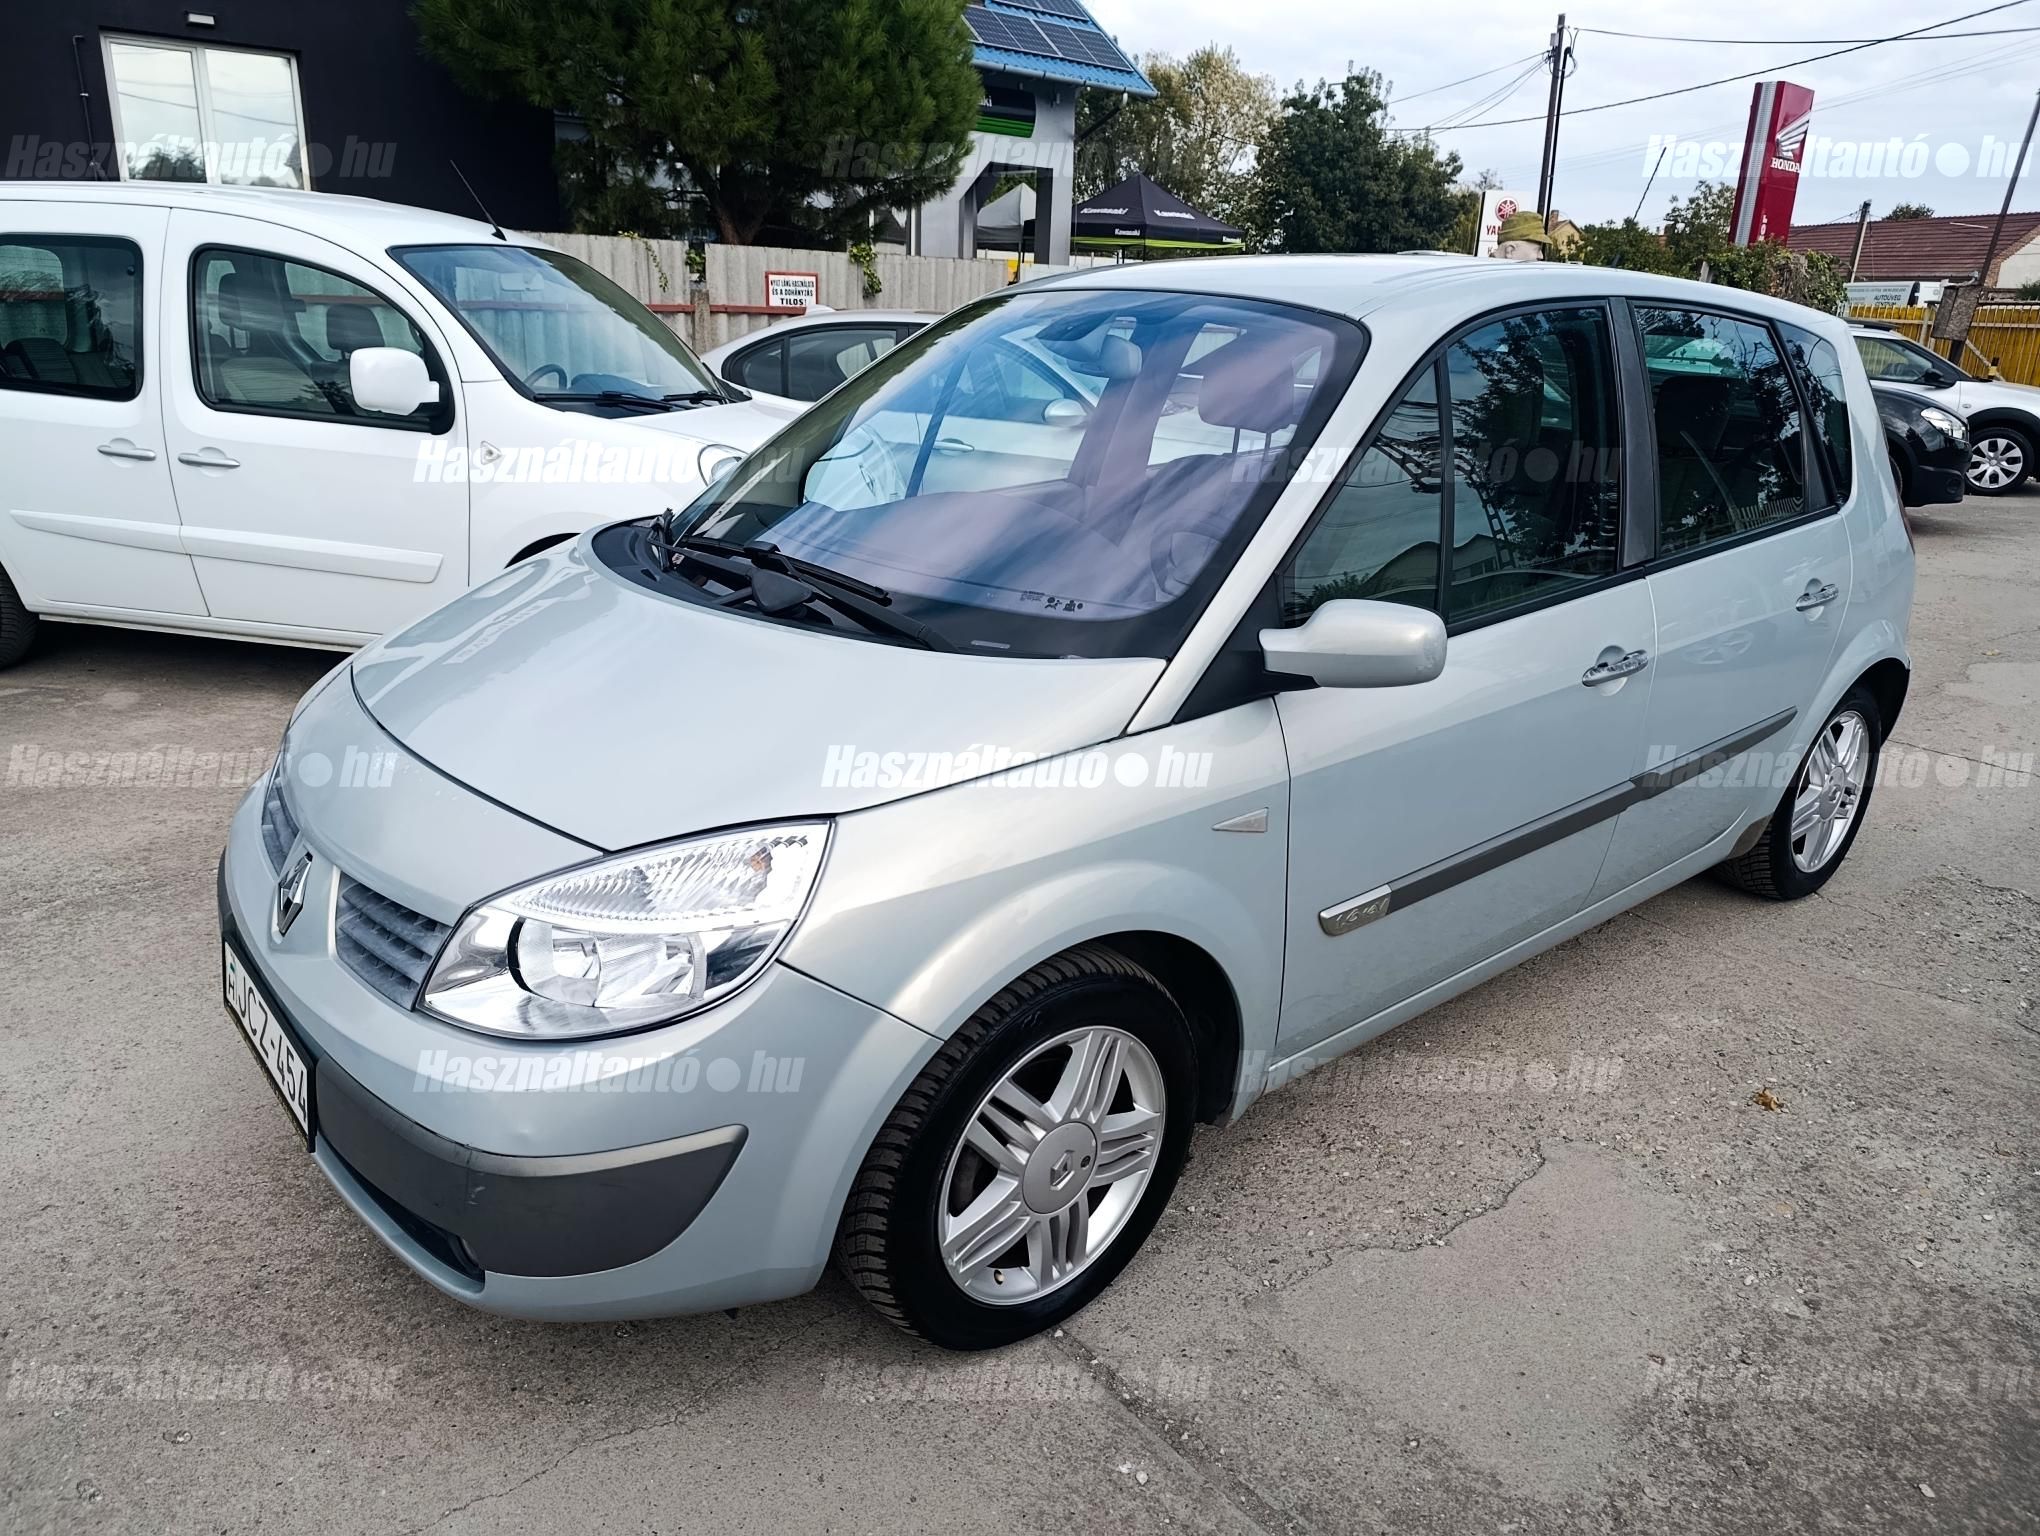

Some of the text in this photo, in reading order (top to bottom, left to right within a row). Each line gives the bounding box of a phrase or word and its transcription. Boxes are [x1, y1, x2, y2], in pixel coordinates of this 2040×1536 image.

[1770, 157, 1801, 174] HONDA
[779, 288, 784, 296] A
[237, 976, 307, 1122] JCZ-454
